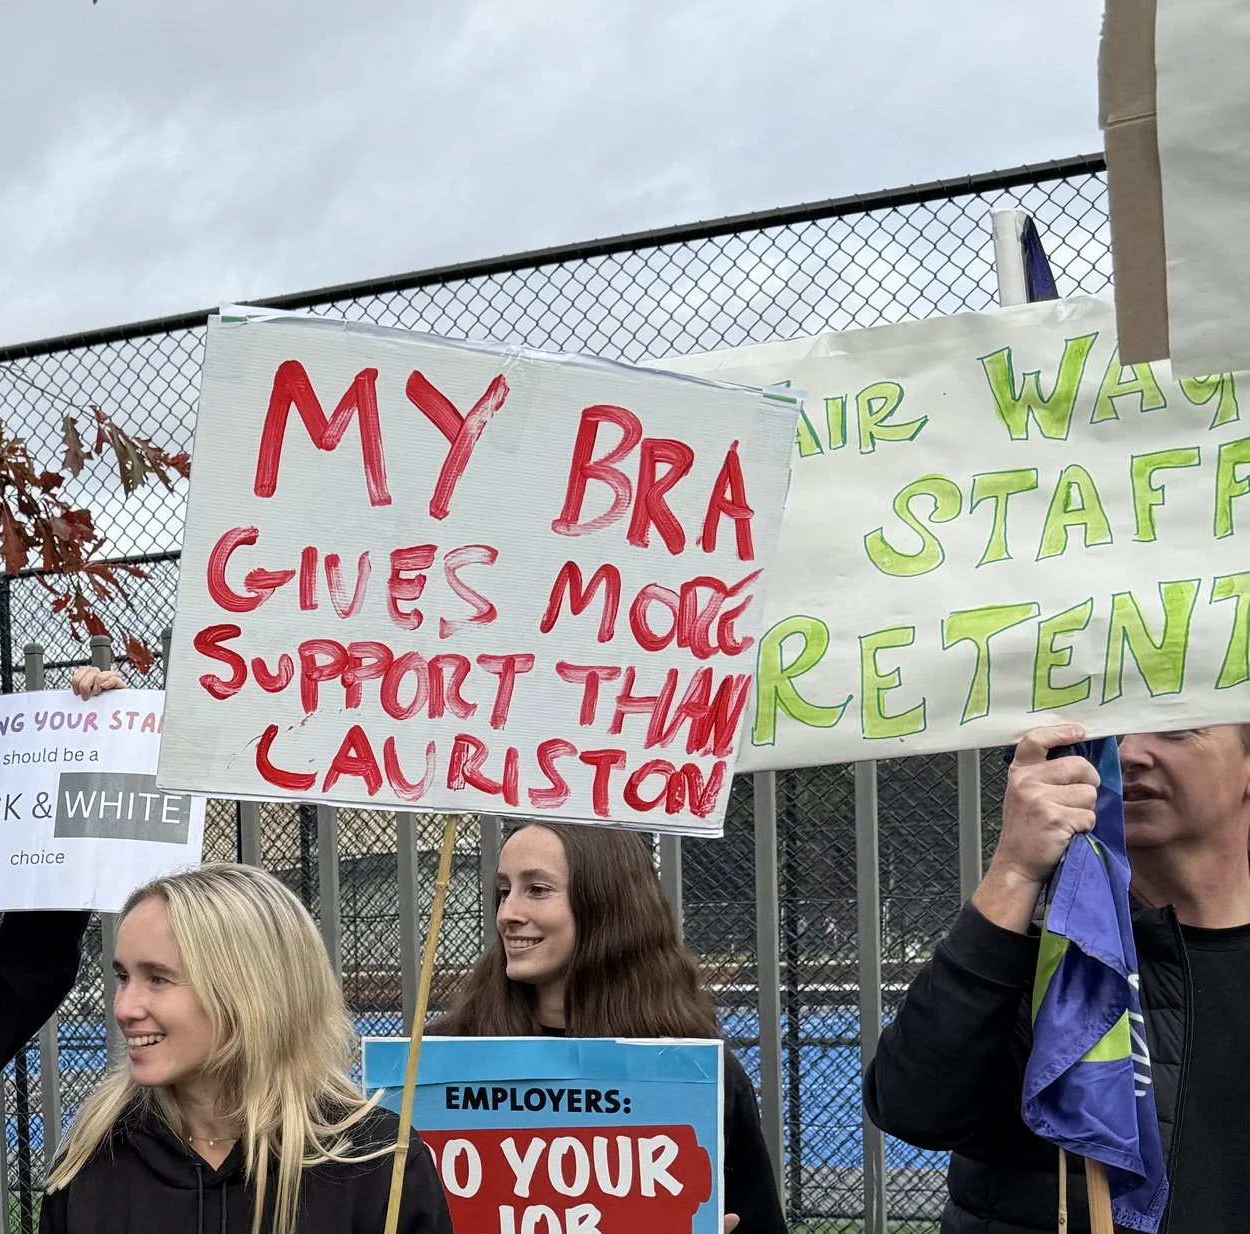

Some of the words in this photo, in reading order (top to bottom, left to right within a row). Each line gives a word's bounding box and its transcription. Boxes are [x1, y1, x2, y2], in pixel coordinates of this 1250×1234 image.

[772, 380, 929, 458] AIR
[253, 359, 511, 521] MY
[551, 404, 755, 561] BRA
[206, 525, 499, 639] GIVES
[34, 711, 99, 733] YOUR
[193, 624, 536, 730] SUPPORT
[555, 661, 755, 759] THAN
[3, 748, 58, 765] should
[63, 749, 84, 762] be
[89, 750, 99, 762] a
[254, 723, 728, 819] LAURISTON
[31, 791, 53, 819] &
[64, 790, 182, 824] WHITE
[10, 850, 65, 866] choice
[445, 1086, 632, 1114] EMPLOYERS:
[423, 1138, 483, 1198] O
[499, 1135, 684, 1198] YOUR
